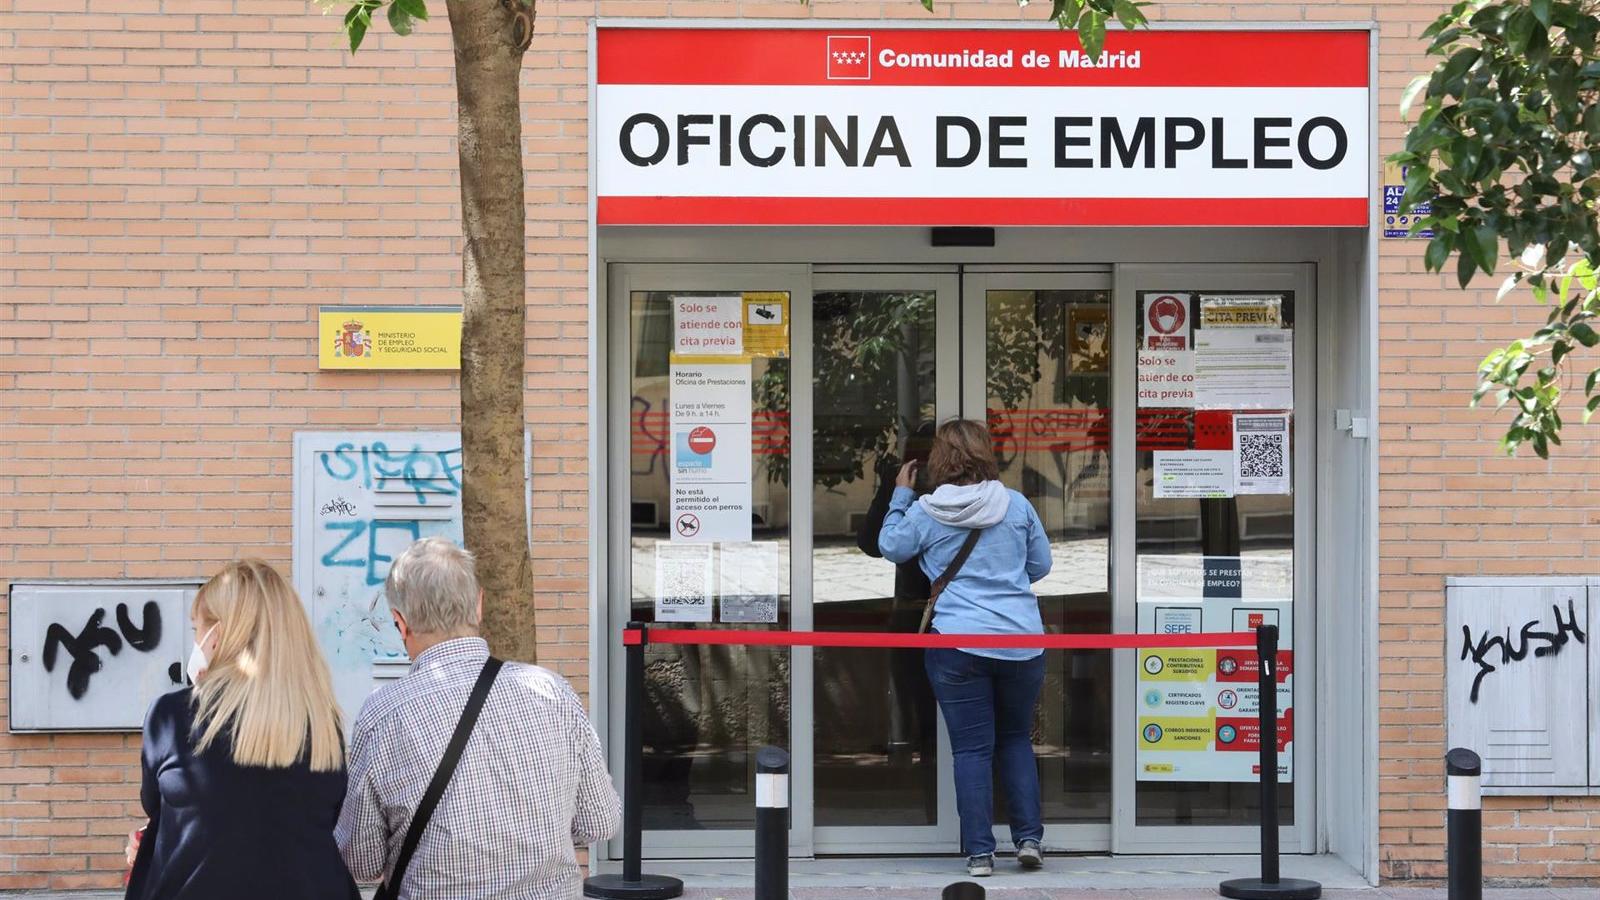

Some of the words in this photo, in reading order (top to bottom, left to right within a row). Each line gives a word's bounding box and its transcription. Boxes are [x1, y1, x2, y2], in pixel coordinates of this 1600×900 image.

[879, 49, 1014, 69] Comunidad
[1020, 49, 1050, 69] de
[1058, 49, 1141, 69] Madrid
[619, 112, 911, 168] OFICINA
[936, 115, 1027, 167] DE
[1054, 116, 1348, 169] EMPLEO
[680, 303, 703, 313] Solo
[706, 305, 717, 313] se
[680, 320, 720, 329] atiende
[724, 321, 742, 329] con
[680, 336, 699, 346] cita
[703, 336, 736, 347] previa
[1139, 356, 1161, 366] Solo
[1164, 357, 1176, 366] se
[1139, 373, 1178, 382] atiende
[1181, 374, 1194, 382] co
[1139, 389, 1158, 398] cita
[1160, 389, 1193, 400] previa
[675, 496, 711, 504] permitido
[719, 504, 743, 512] perros
[1207, 580, 1241, 588] EMPLEO?
[1164, 624, 1192, 633] SEPE
